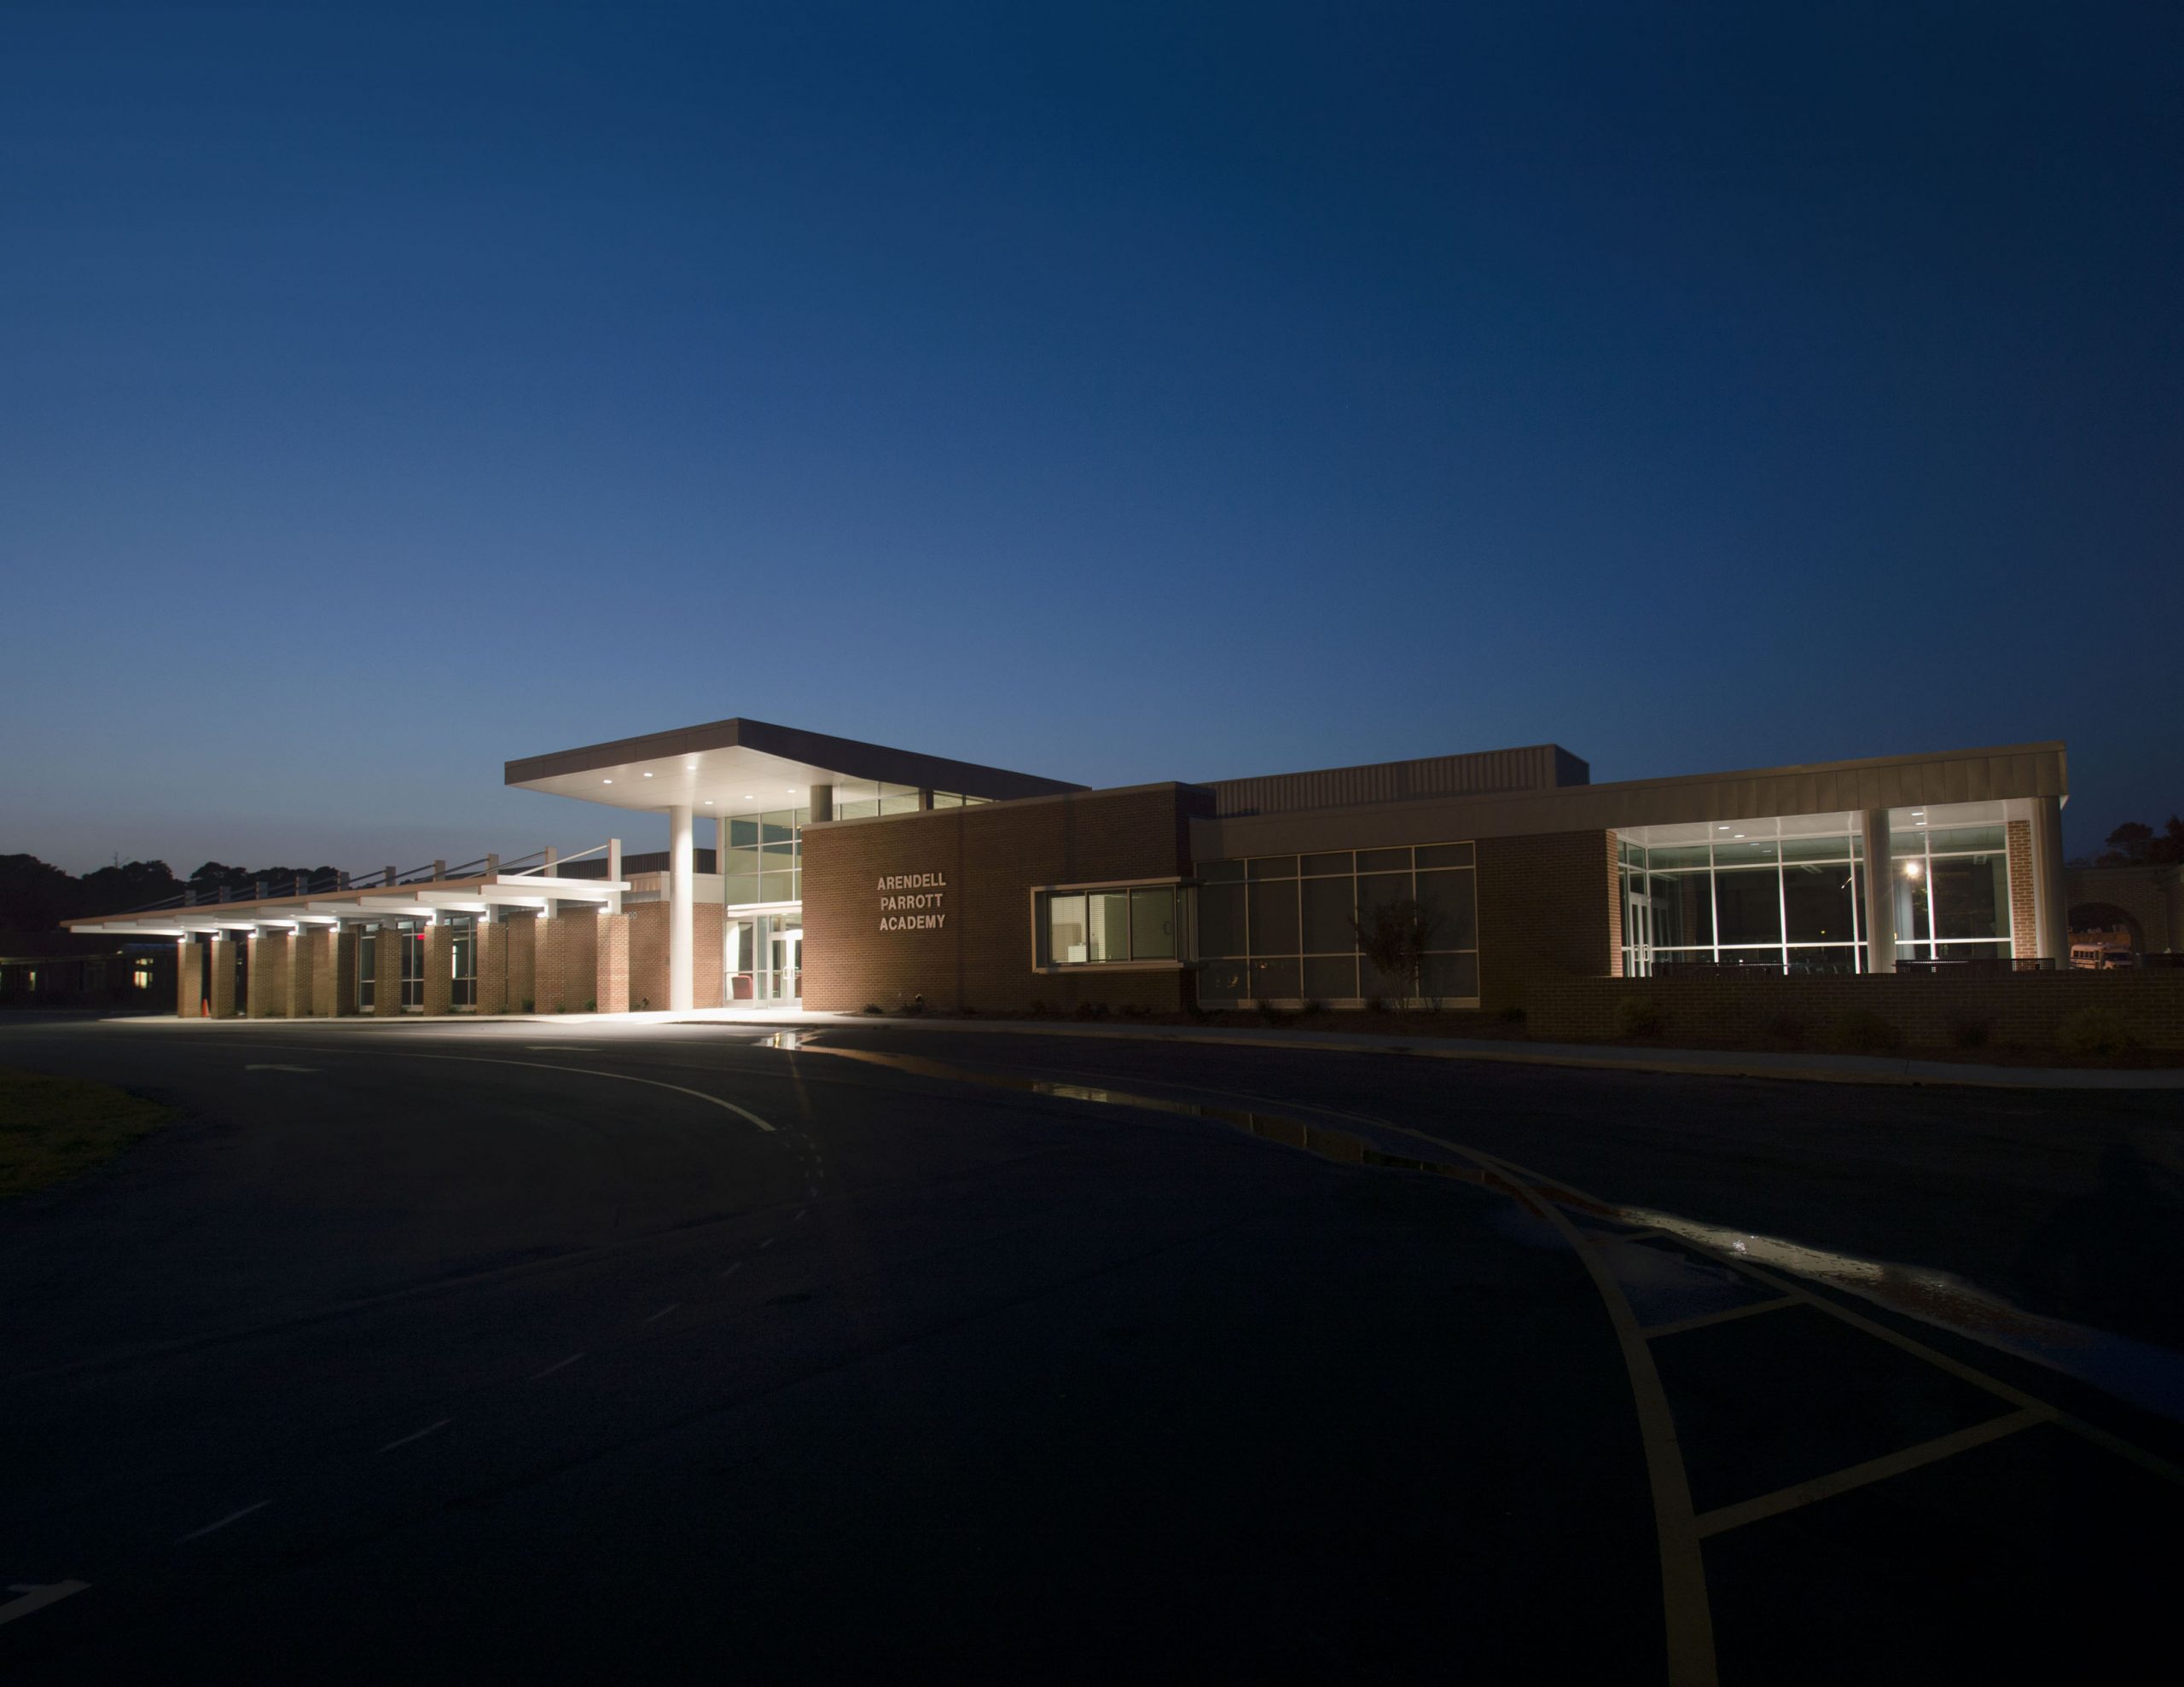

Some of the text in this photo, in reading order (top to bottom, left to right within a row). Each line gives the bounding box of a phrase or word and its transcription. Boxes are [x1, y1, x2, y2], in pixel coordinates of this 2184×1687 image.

[877, 872, 947, 890] ARENDELL
[880, 893, 944, 911] PARROTT
[879, 913, 946, 931] ACADEMY
